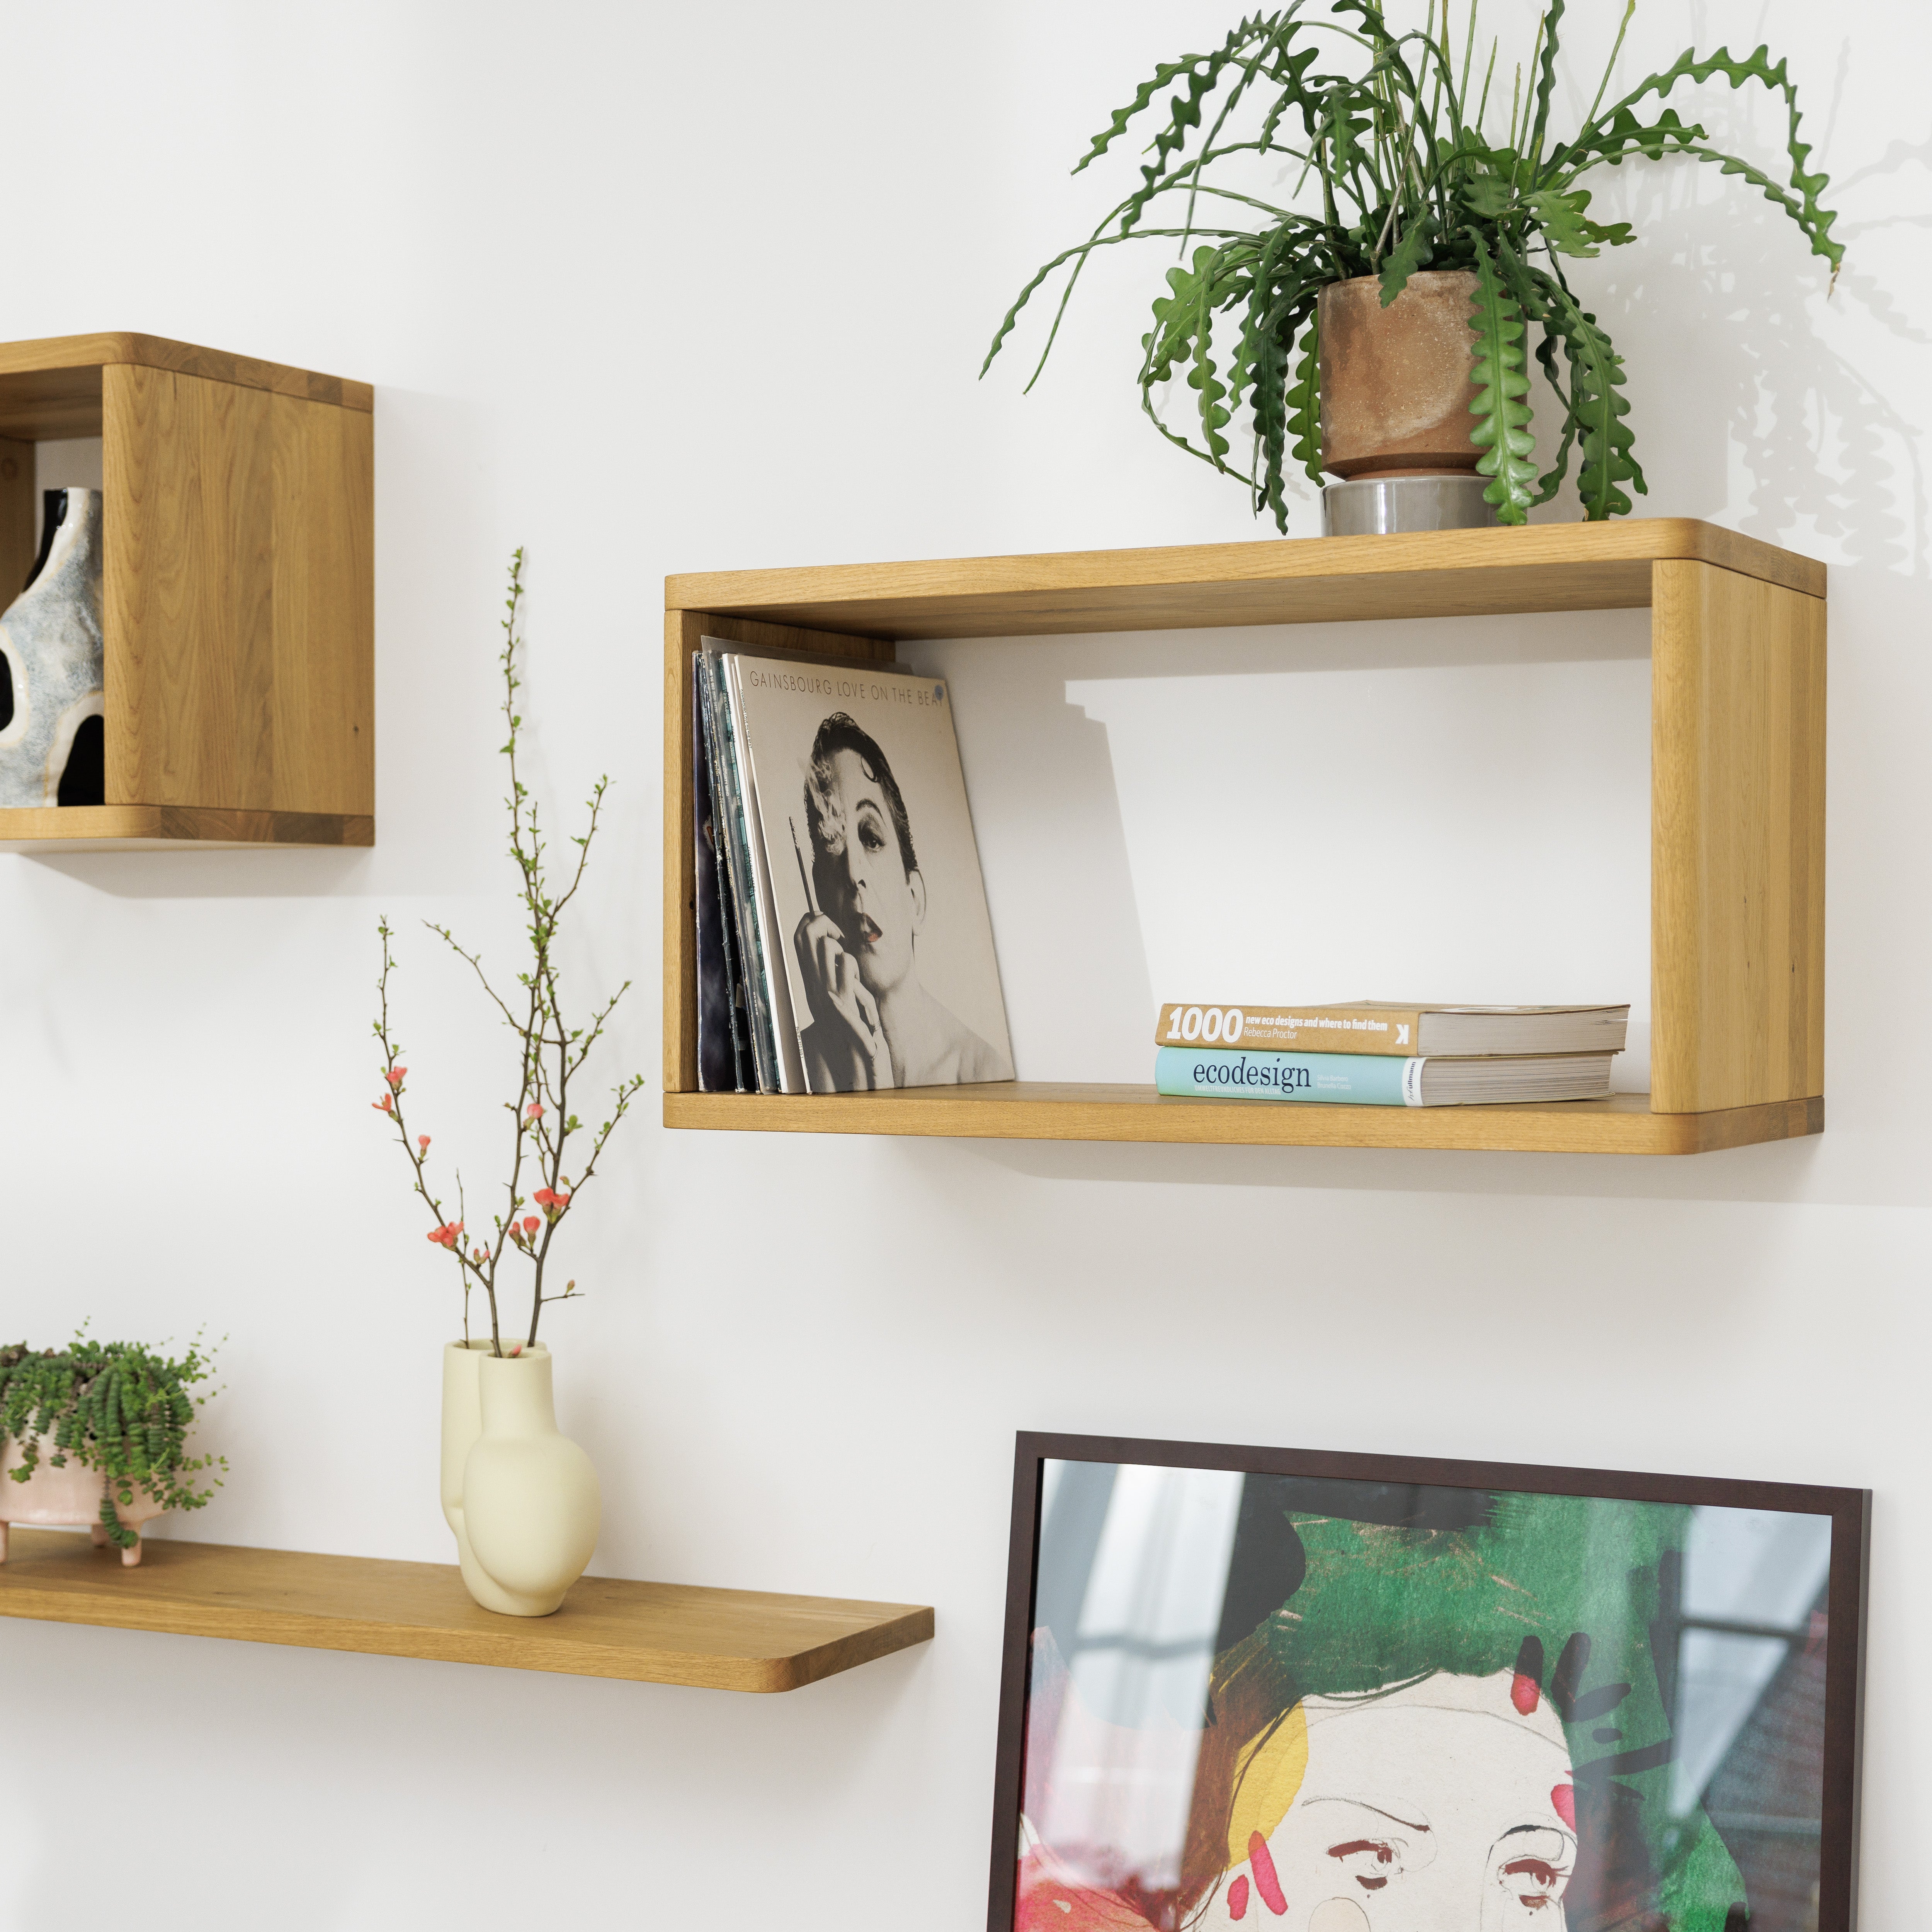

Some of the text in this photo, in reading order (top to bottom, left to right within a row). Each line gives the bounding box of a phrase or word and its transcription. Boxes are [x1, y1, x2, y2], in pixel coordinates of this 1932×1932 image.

[750, 671, 942, 707] GAINSBOURG LOVE ON THE BEAT
[1167, 1007, 1388, 1043] 1000 new eco designs and where to find them
[1244, 1027, 1297, 1039] Rebecca Proctor
[1194, 1057, 1311, 1093] ecodesign
[1194, 1085, 1245, 1094] UMWELTFREUNDLICHES
